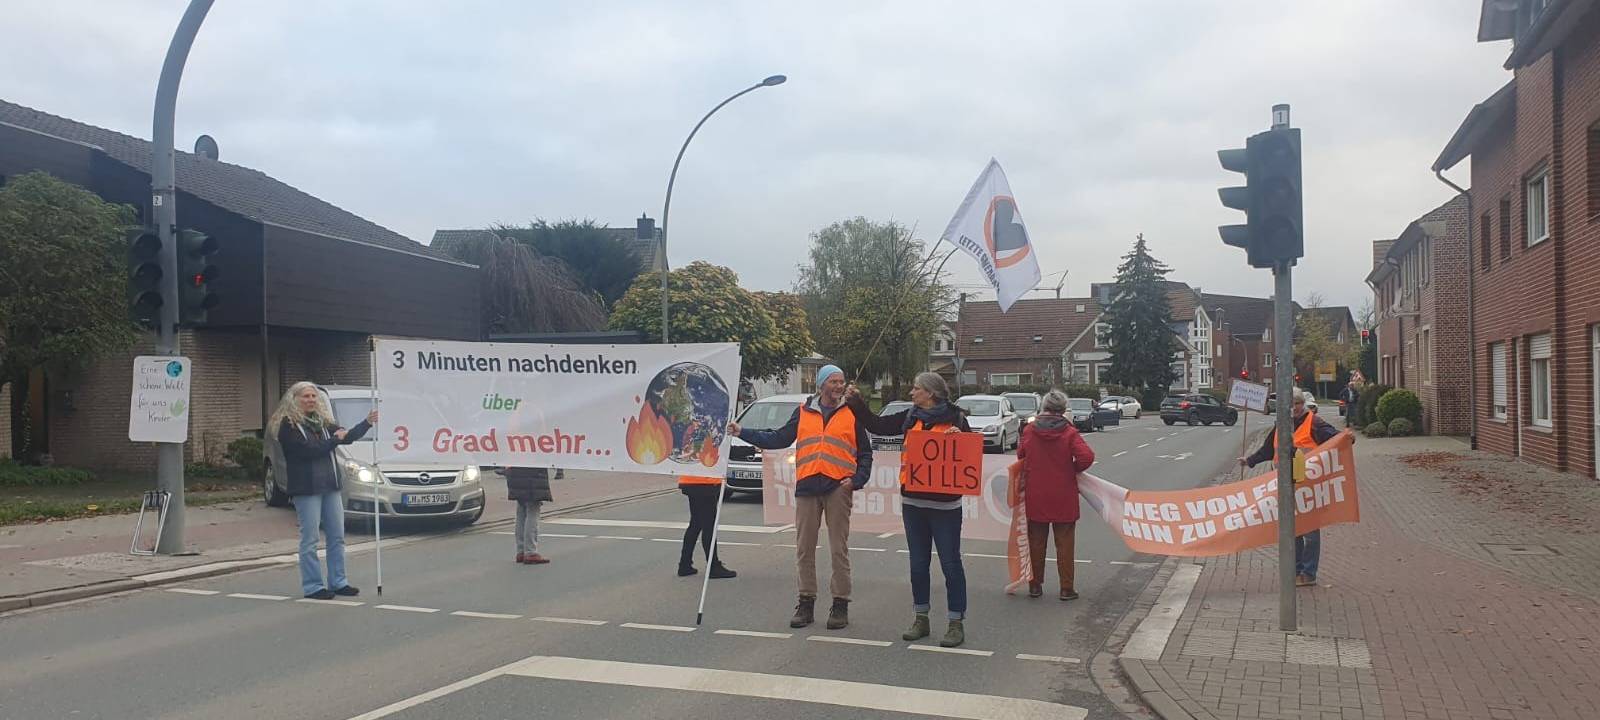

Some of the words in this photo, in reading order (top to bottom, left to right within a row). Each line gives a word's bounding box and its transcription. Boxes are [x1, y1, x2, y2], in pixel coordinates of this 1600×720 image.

[959, 234, 983, 257] LETZTE
[393, 350, 405, 369] 3
[417, 351, 501, 372] Minuten
[483, 393, 522, 411] über
[393, 426, 409, 451] 3
[432, 427, 499, 454] Grad
[506, 428, 611, 456] mehr...
[922, 438, 962, 462] OIL
[910, 463, 979, 490] KILLS
[1122, 518, 1174, 545] HIN
[1179, 519, 1217, 545] ZU
[1223, 475, 1347, 532] GERCHT
[1184, 491, 1247, 520] VON
